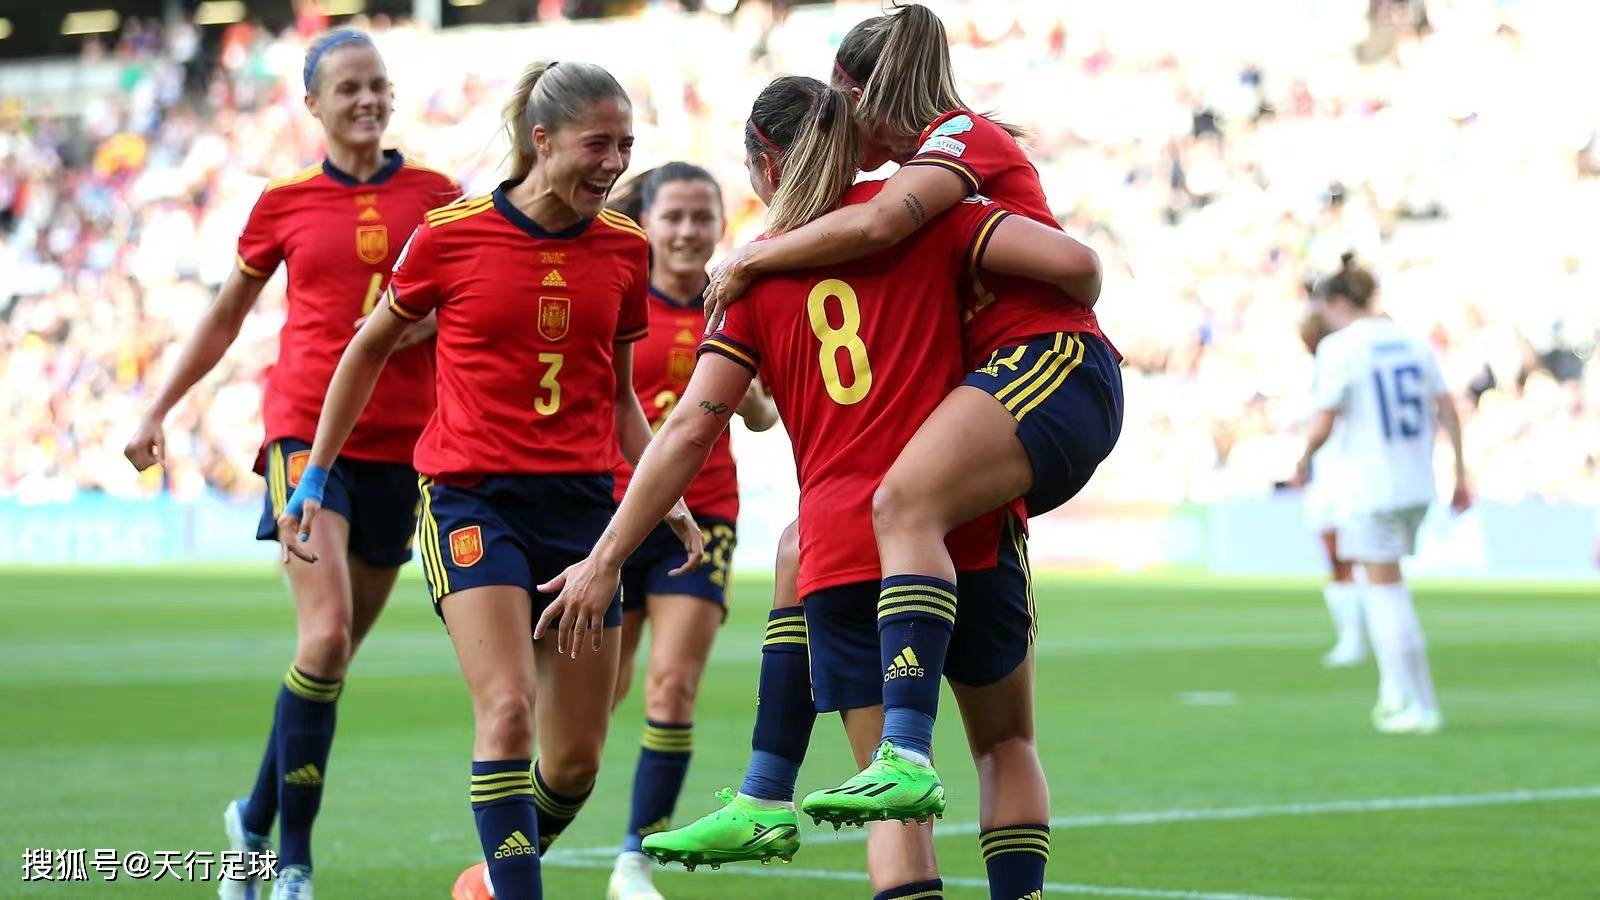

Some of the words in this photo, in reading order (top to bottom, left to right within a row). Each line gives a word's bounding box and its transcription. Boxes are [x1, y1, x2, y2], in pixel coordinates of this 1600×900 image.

[807, 278, 873, 405] 8
[534, 353, 563, 415] 3
[1373, 366, 1422, 442] 15
[884, 665, 925, 682] adidas
[494, 845, 536, 859] adidas
